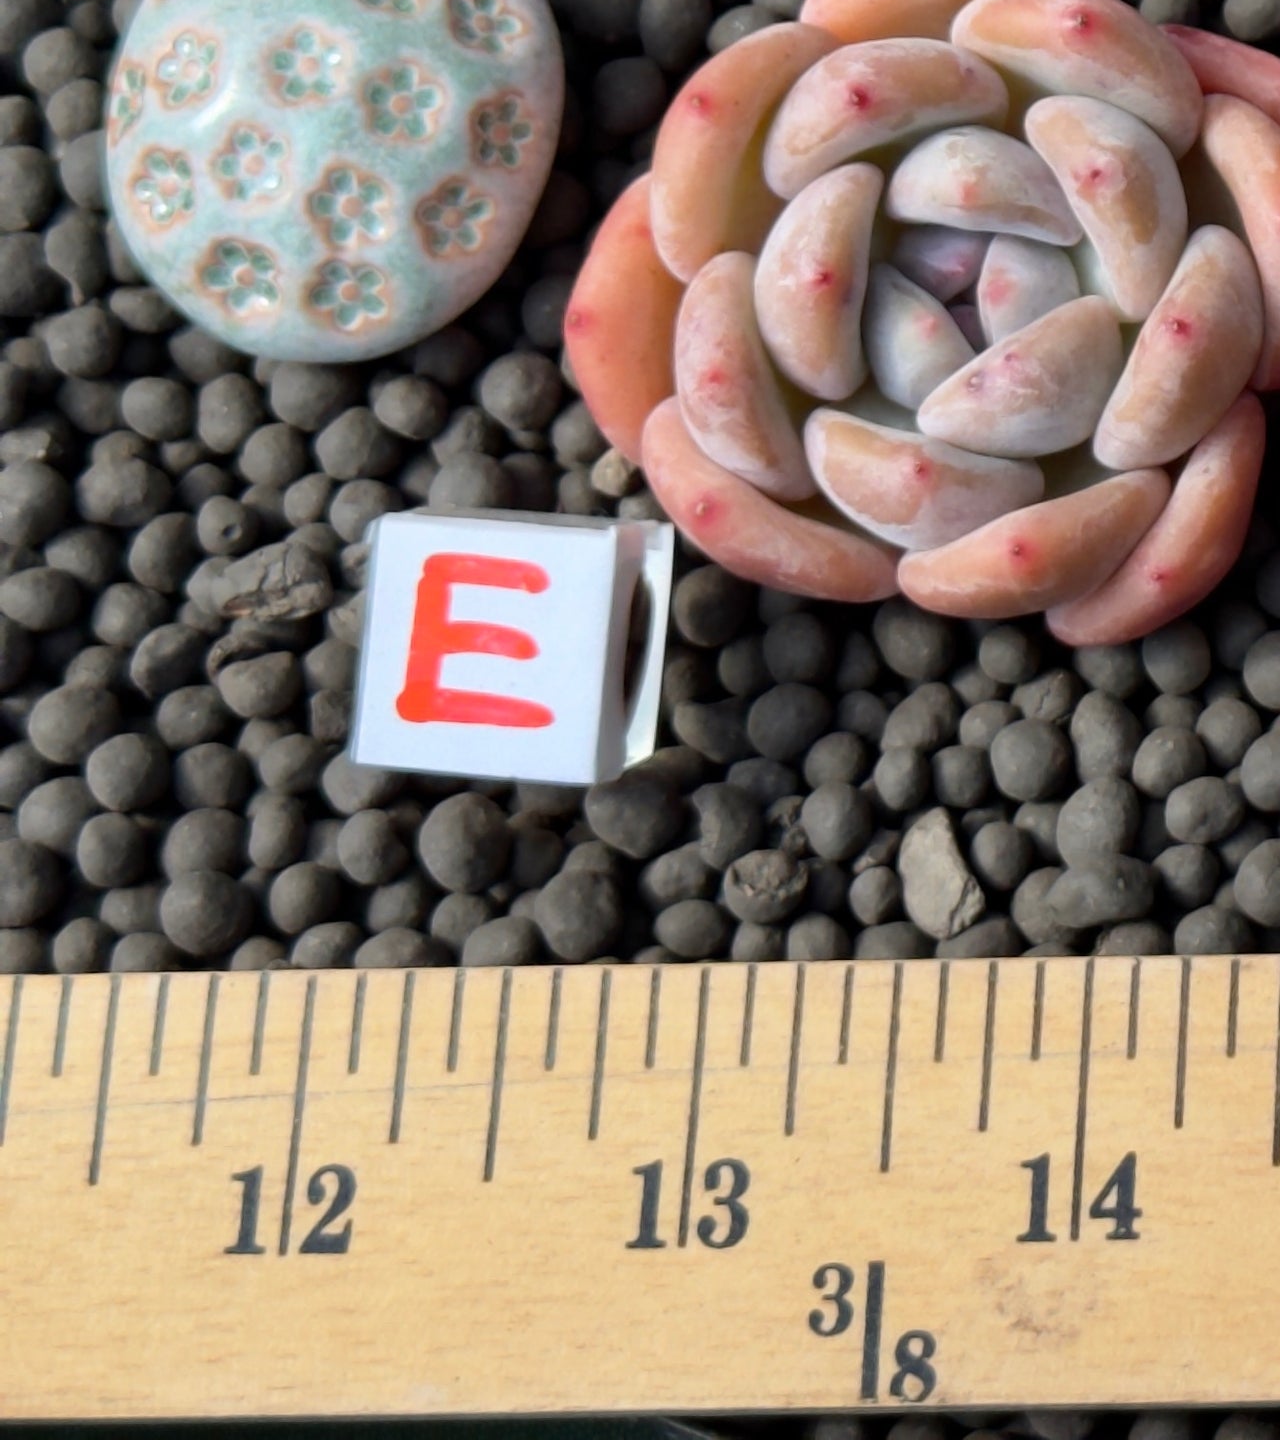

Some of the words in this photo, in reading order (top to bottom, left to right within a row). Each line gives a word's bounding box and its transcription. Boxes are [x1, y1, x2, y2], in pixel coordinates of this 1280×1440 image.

[396, 555, 552, 727] E
[225, 1164, 355, 1255] 12
[626, 1157, 749, 1249] 13
[1017, 1152, 1142, 1244] 14
